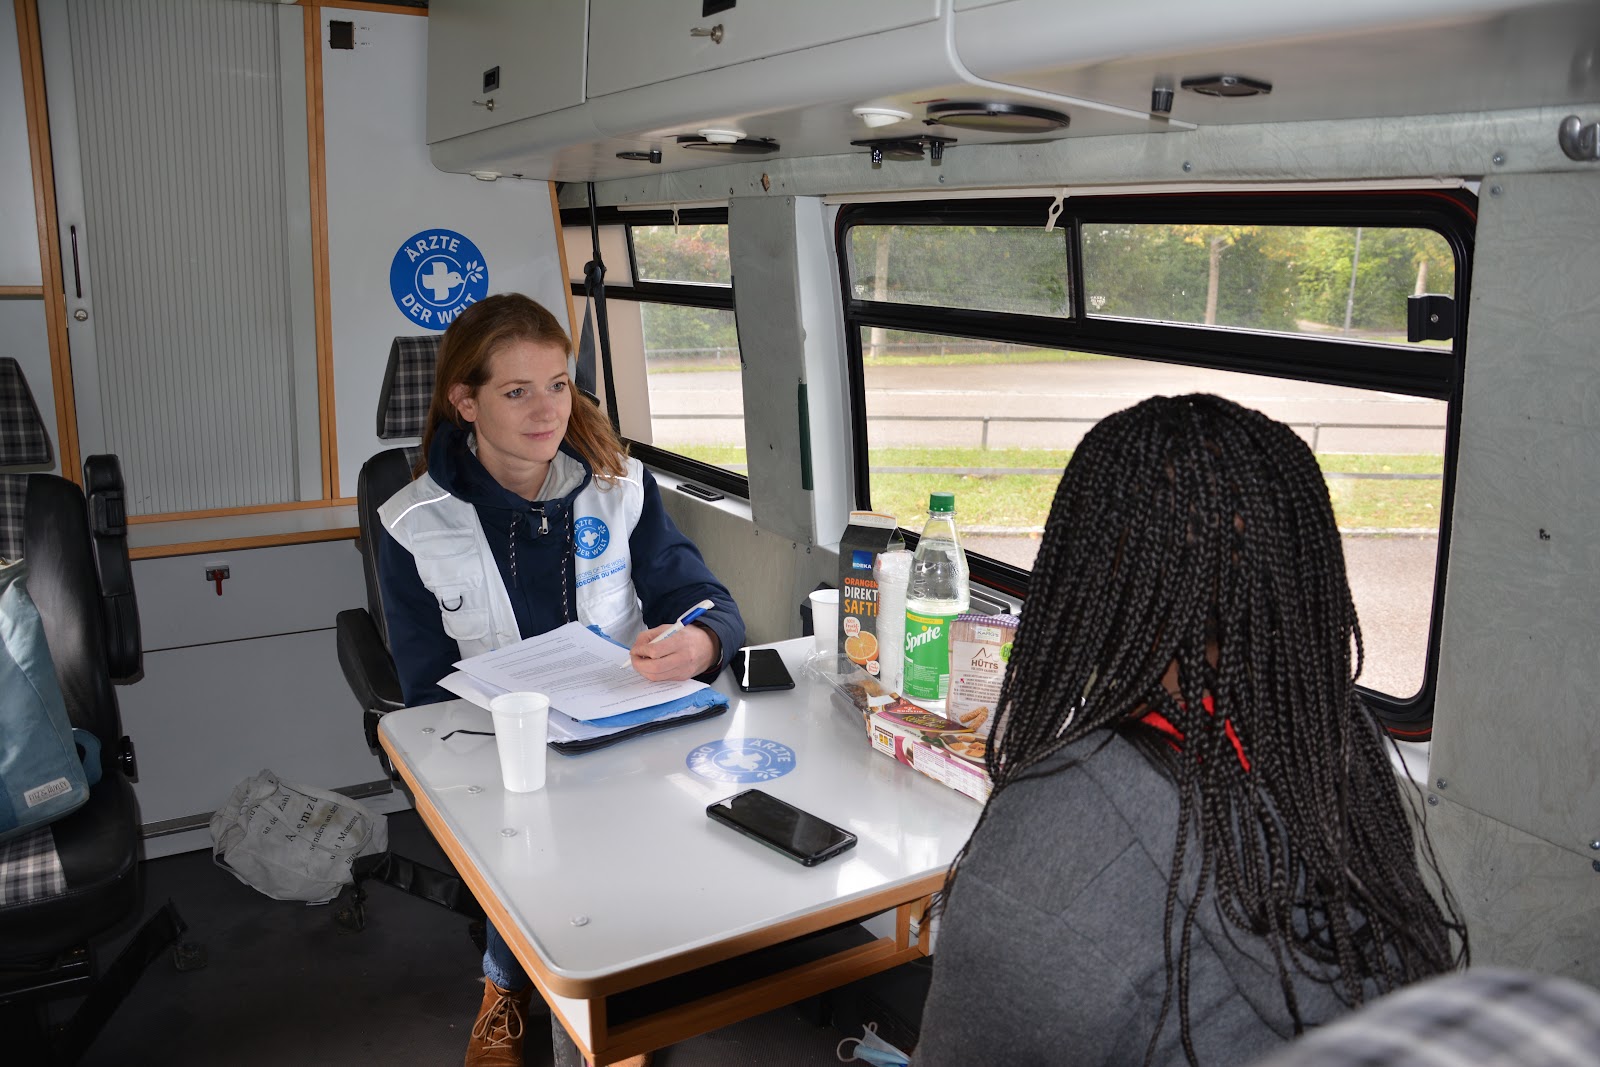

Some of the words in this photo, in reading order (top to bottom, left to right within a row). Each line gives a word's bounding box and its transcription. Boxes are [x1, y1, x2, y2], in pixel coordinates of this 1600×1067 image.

[404, 236, 460, 262] ÄRZTE
[402, 294, 432, 323] DER
[577, 548, 590, 557] DER
[592, 538, 607, 556] WELT
[845, 586, 878, 601] DIREKT
[844, 599, 877, 617] SAFT!
[906, 626, 941, 652] Sprite
[972, 659, 998, 669] HÜTTS
[750, 739, 791, 763] ÄRZTE
[262, 826, 272, 835] an
[330, 844, 341, 860] ud
